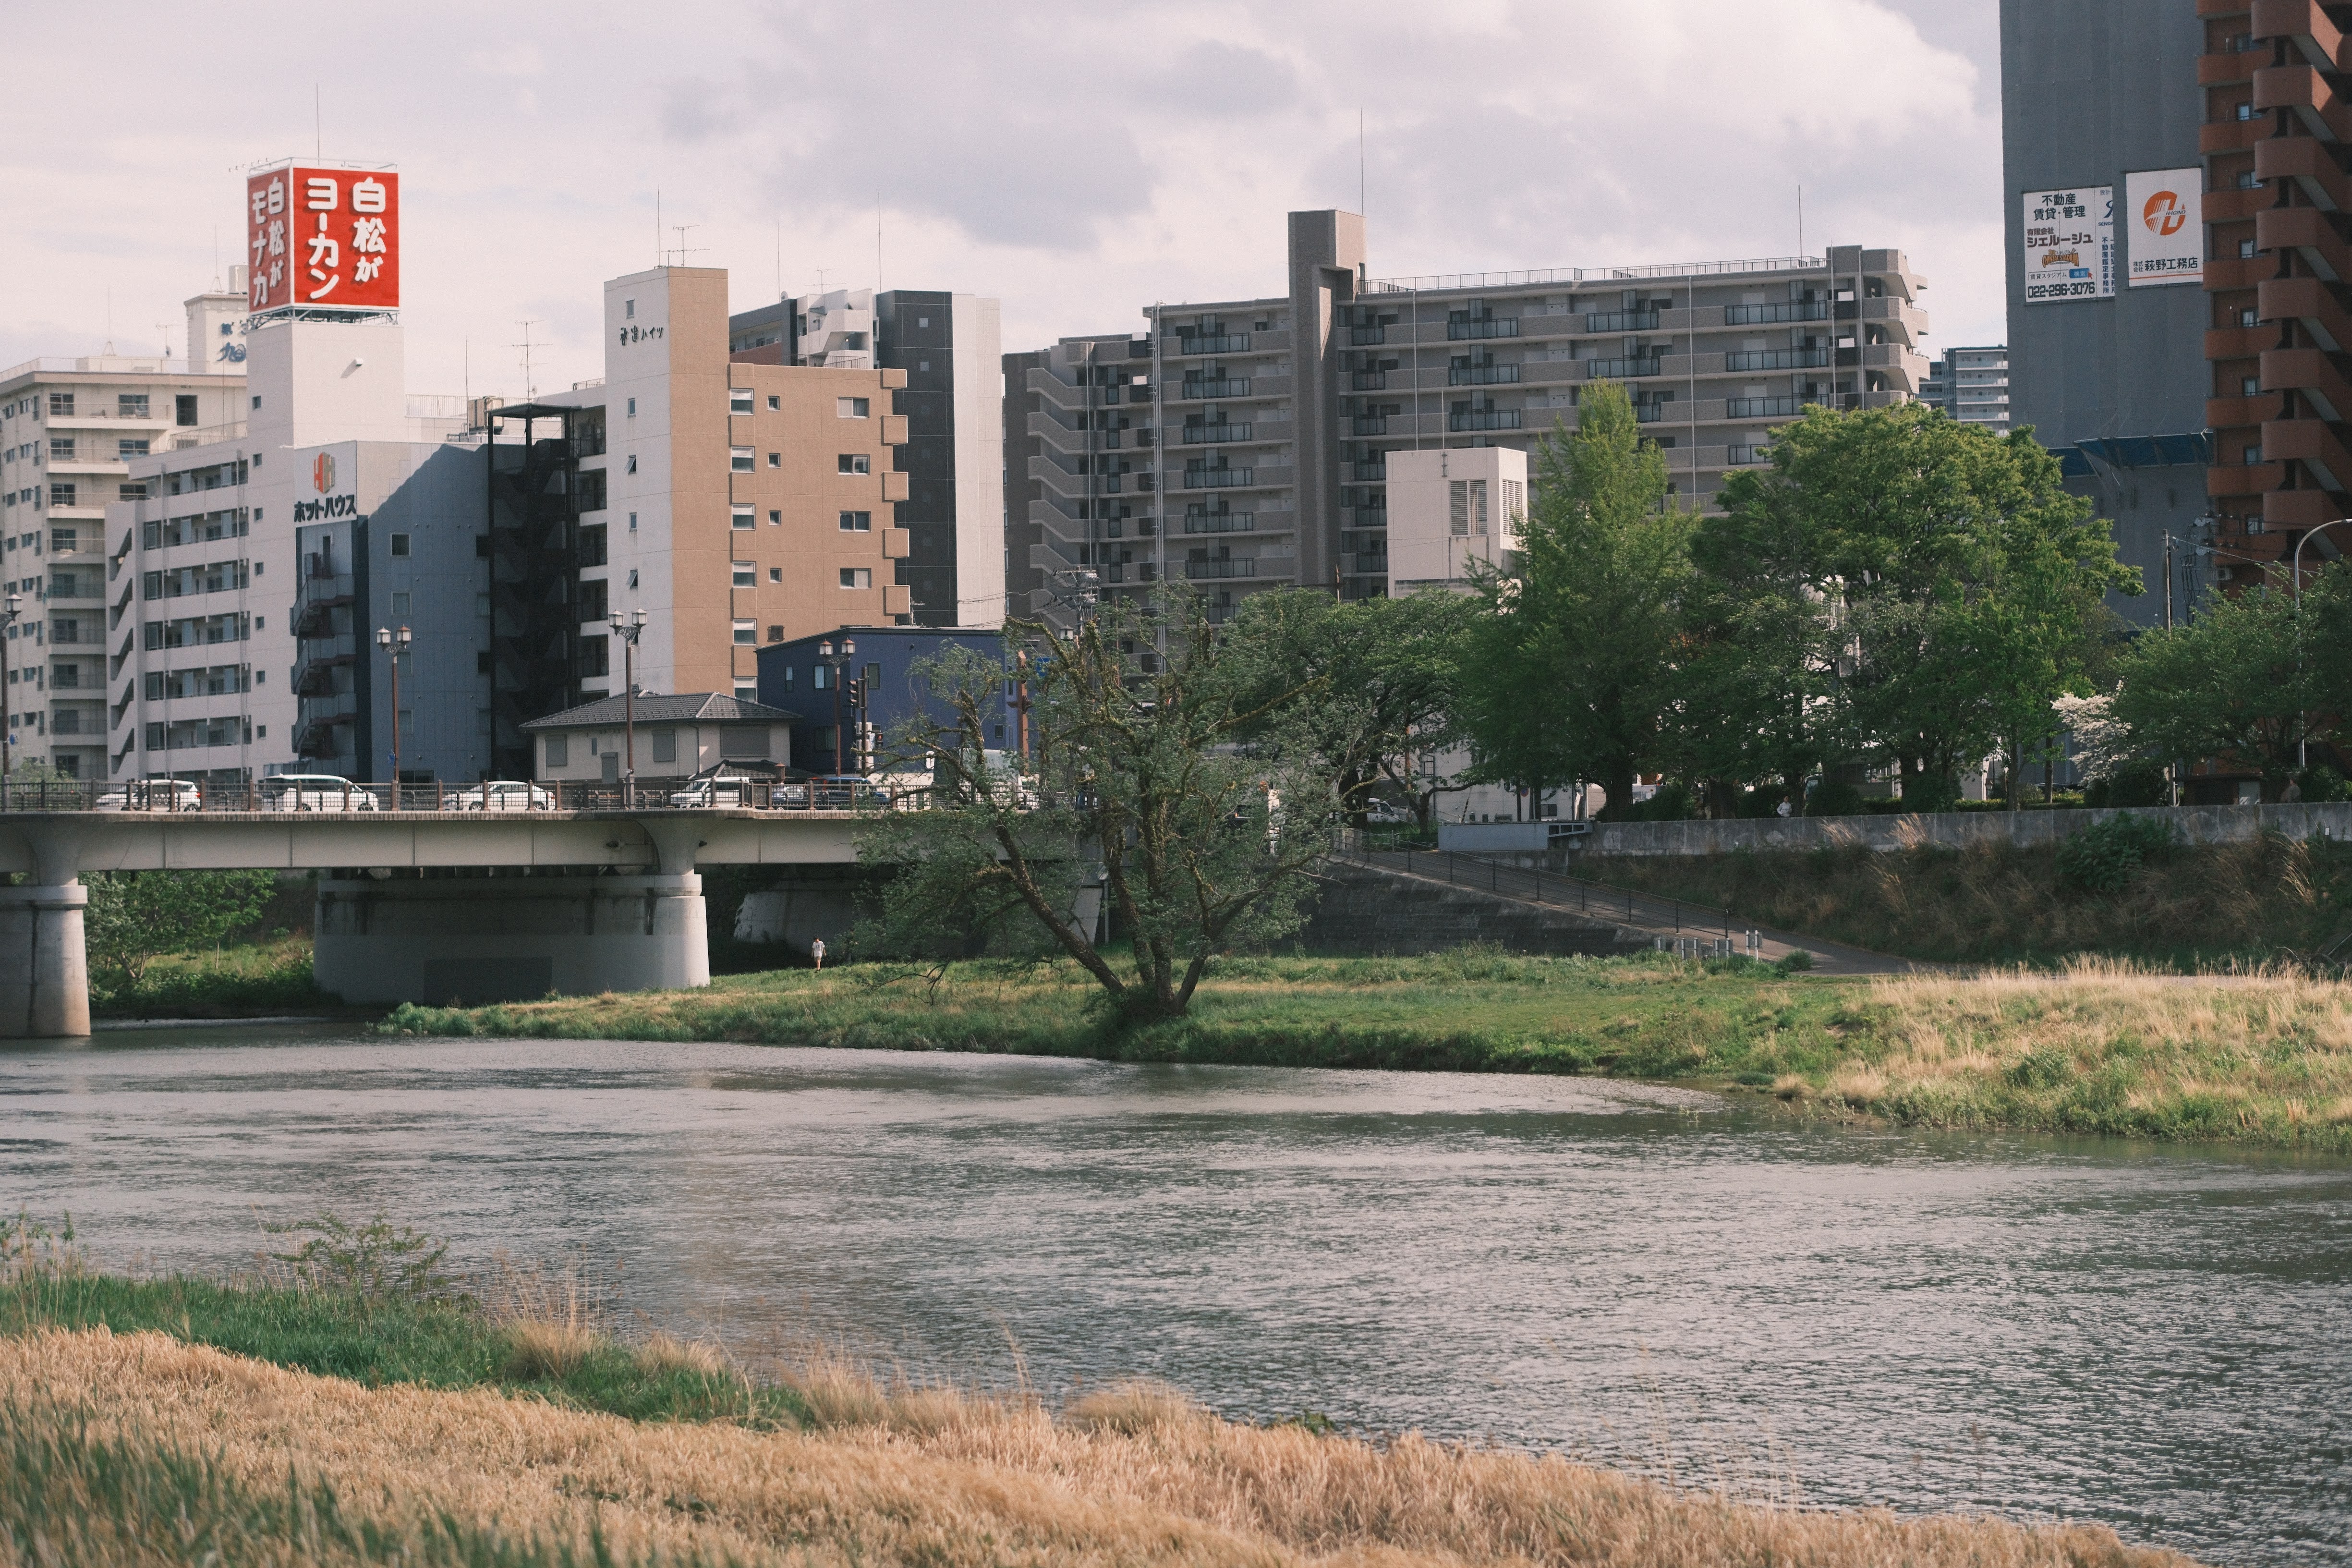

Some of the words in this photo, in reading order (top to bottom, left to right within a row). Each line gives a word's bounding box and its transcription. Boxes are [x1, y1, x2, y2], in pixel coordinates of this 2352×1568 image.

[2042, 193, 2076, 207] 不動産
[268, 176, 285, 288] 白松が
[308, 177, 339, 299] ヨーカン
[353, 177, 386, 282] 白松が
[2027, 227, 2054, 236] 有限会社
[252, 190, 268, 306] モナカ
[2145, 257, 2198, 271] 萩野工務店
[2027, 281, 2095, 298] 022-296-3076
[294, 494, 356, 523] ホットハウス
